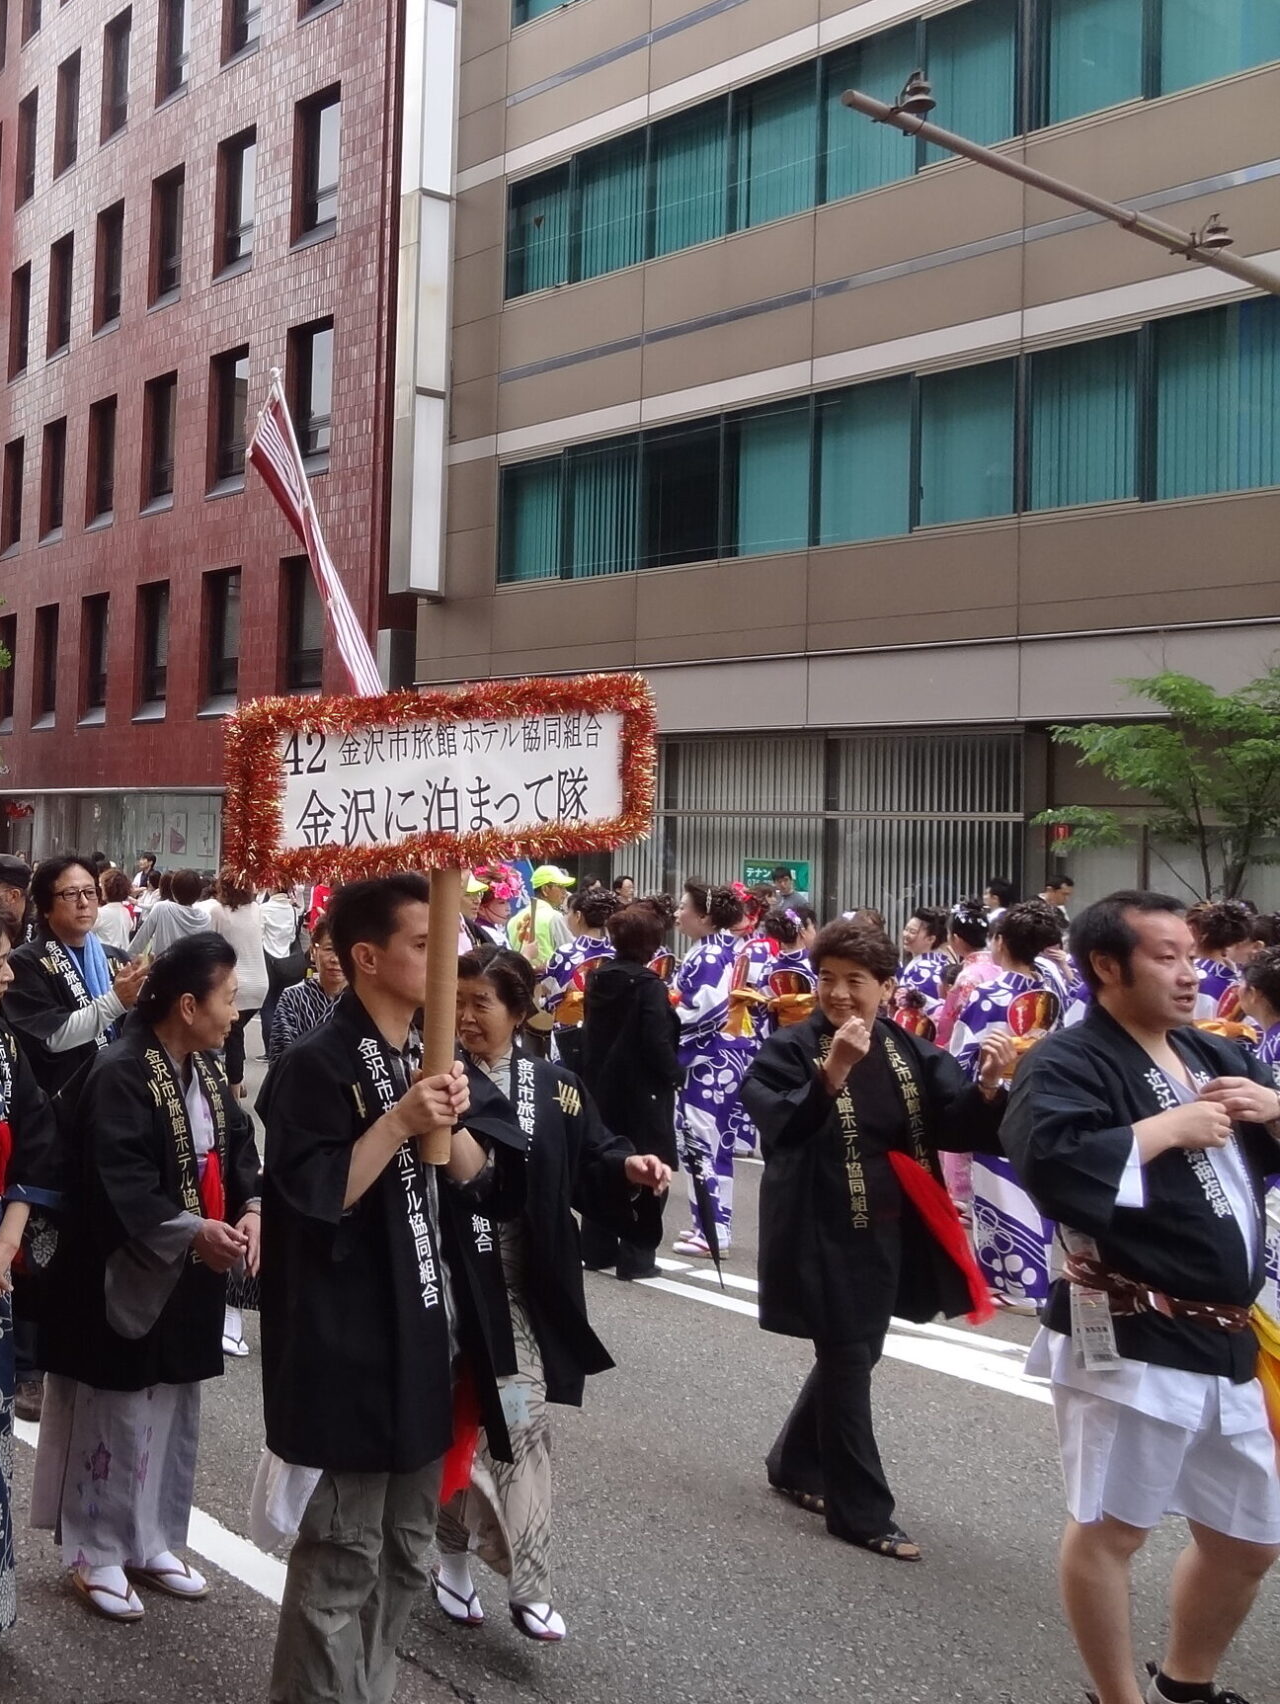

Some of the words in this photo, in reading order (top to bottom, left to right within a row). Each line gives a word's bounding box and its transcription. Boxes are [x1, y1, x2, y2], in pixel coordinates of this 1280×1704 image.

[283, 731, 327, 776] 42
[338, 714, 603, 768] 金沢市旅館ホテル協同組合
[295, 766, 589, 847] 金沢に泊まって隊
